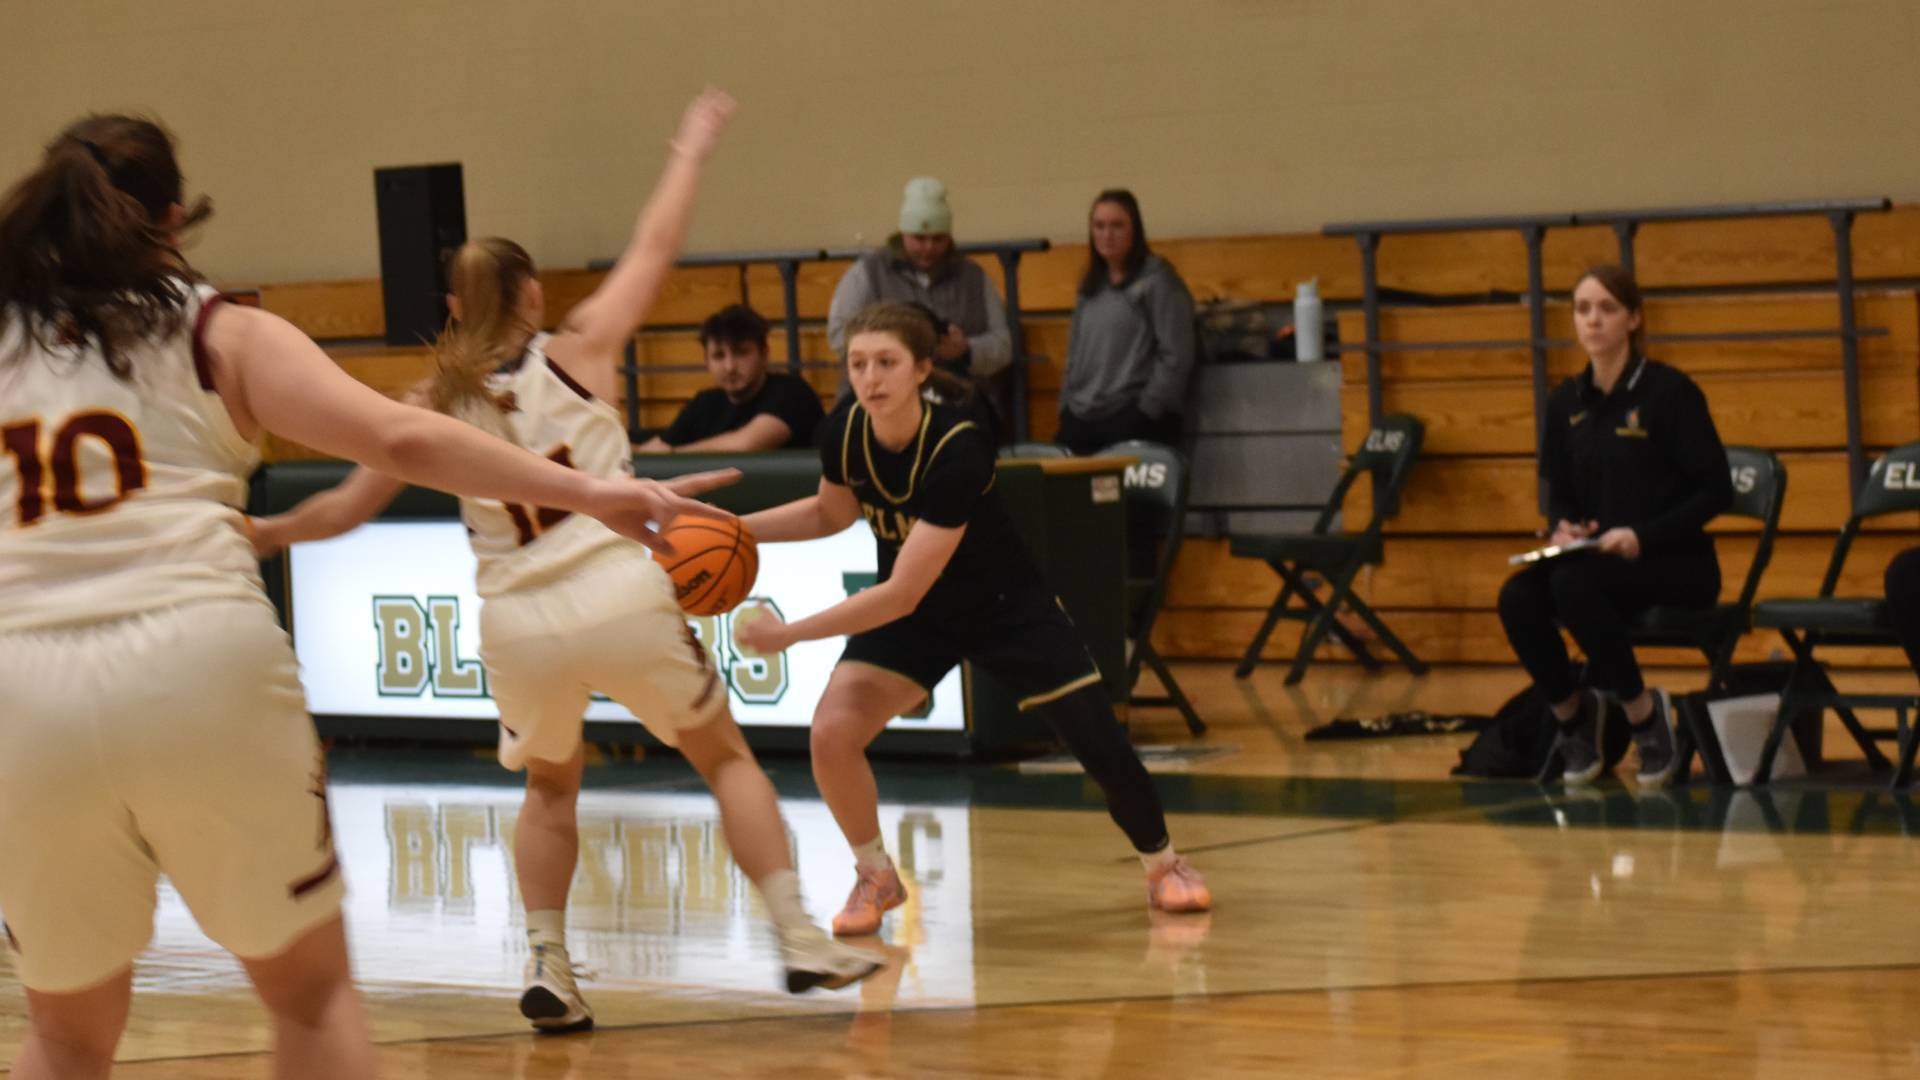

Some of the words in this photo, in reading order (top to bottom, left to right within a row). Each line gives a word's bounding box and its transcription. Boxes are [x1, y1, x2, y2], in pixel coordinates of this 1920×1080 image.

[0, 408, 147, 528] 10
[1123, 462, 1167, 488] MS
[1883, 461, 1920, 489] EL
[861, 502, 921, 541] ELM
